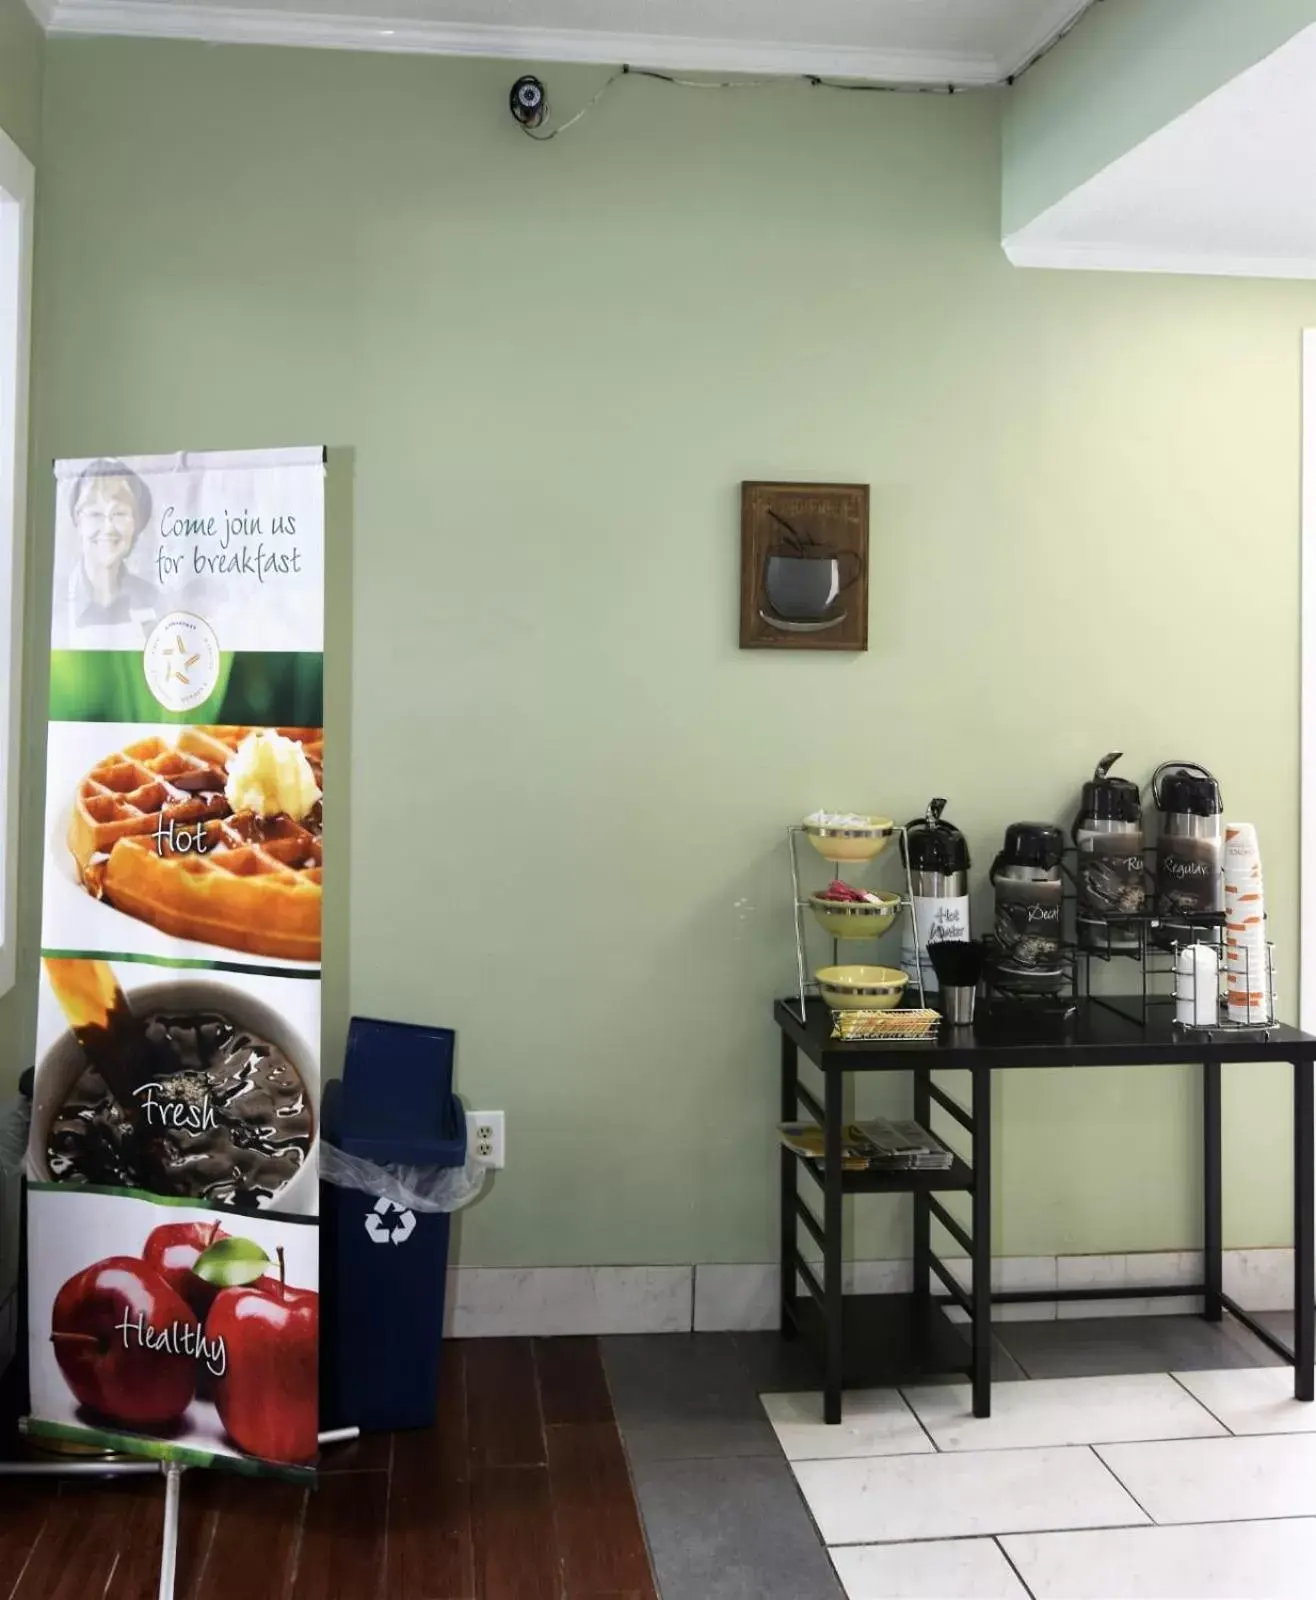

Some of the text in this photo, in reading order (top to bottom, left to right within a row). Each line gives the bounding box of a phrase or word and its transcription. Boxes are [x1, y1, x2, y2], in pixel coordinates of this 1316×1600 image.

[160, 506, 296, 549] Come join us
[155, 543, 302, 584] for breakfast
[151, 811, 207, 856] Hot
[1163, 855, 1208, 880] Regular
[934, 905, 960, 924] Hot
[132, 1082, 219, 1131] Fresh
[114, 1305, 226, 1376] Healthy
